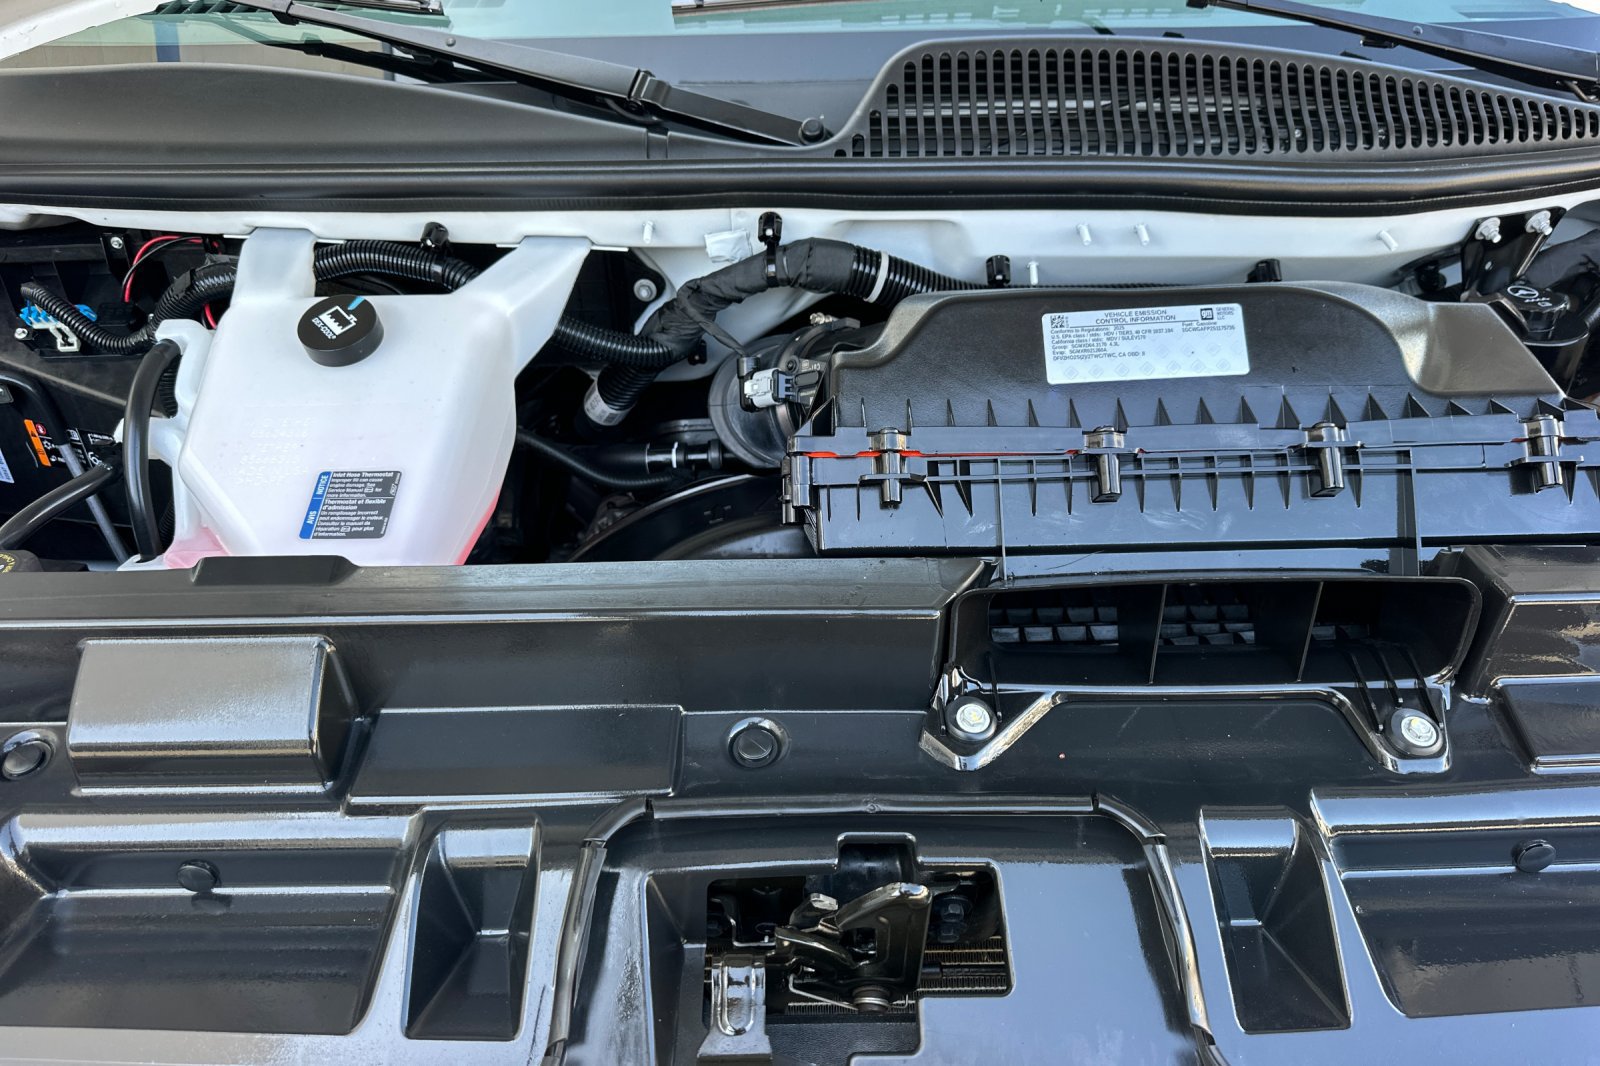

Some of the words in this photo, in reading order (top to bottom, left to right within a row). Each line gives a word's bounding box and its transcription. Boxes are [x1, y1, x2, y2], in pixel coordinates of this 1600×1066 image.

[1096, 317, 1128, 325] CONTROL
[316, 475, 328, 494] NOTICE
[306, 511, 317, 524] AVIS
